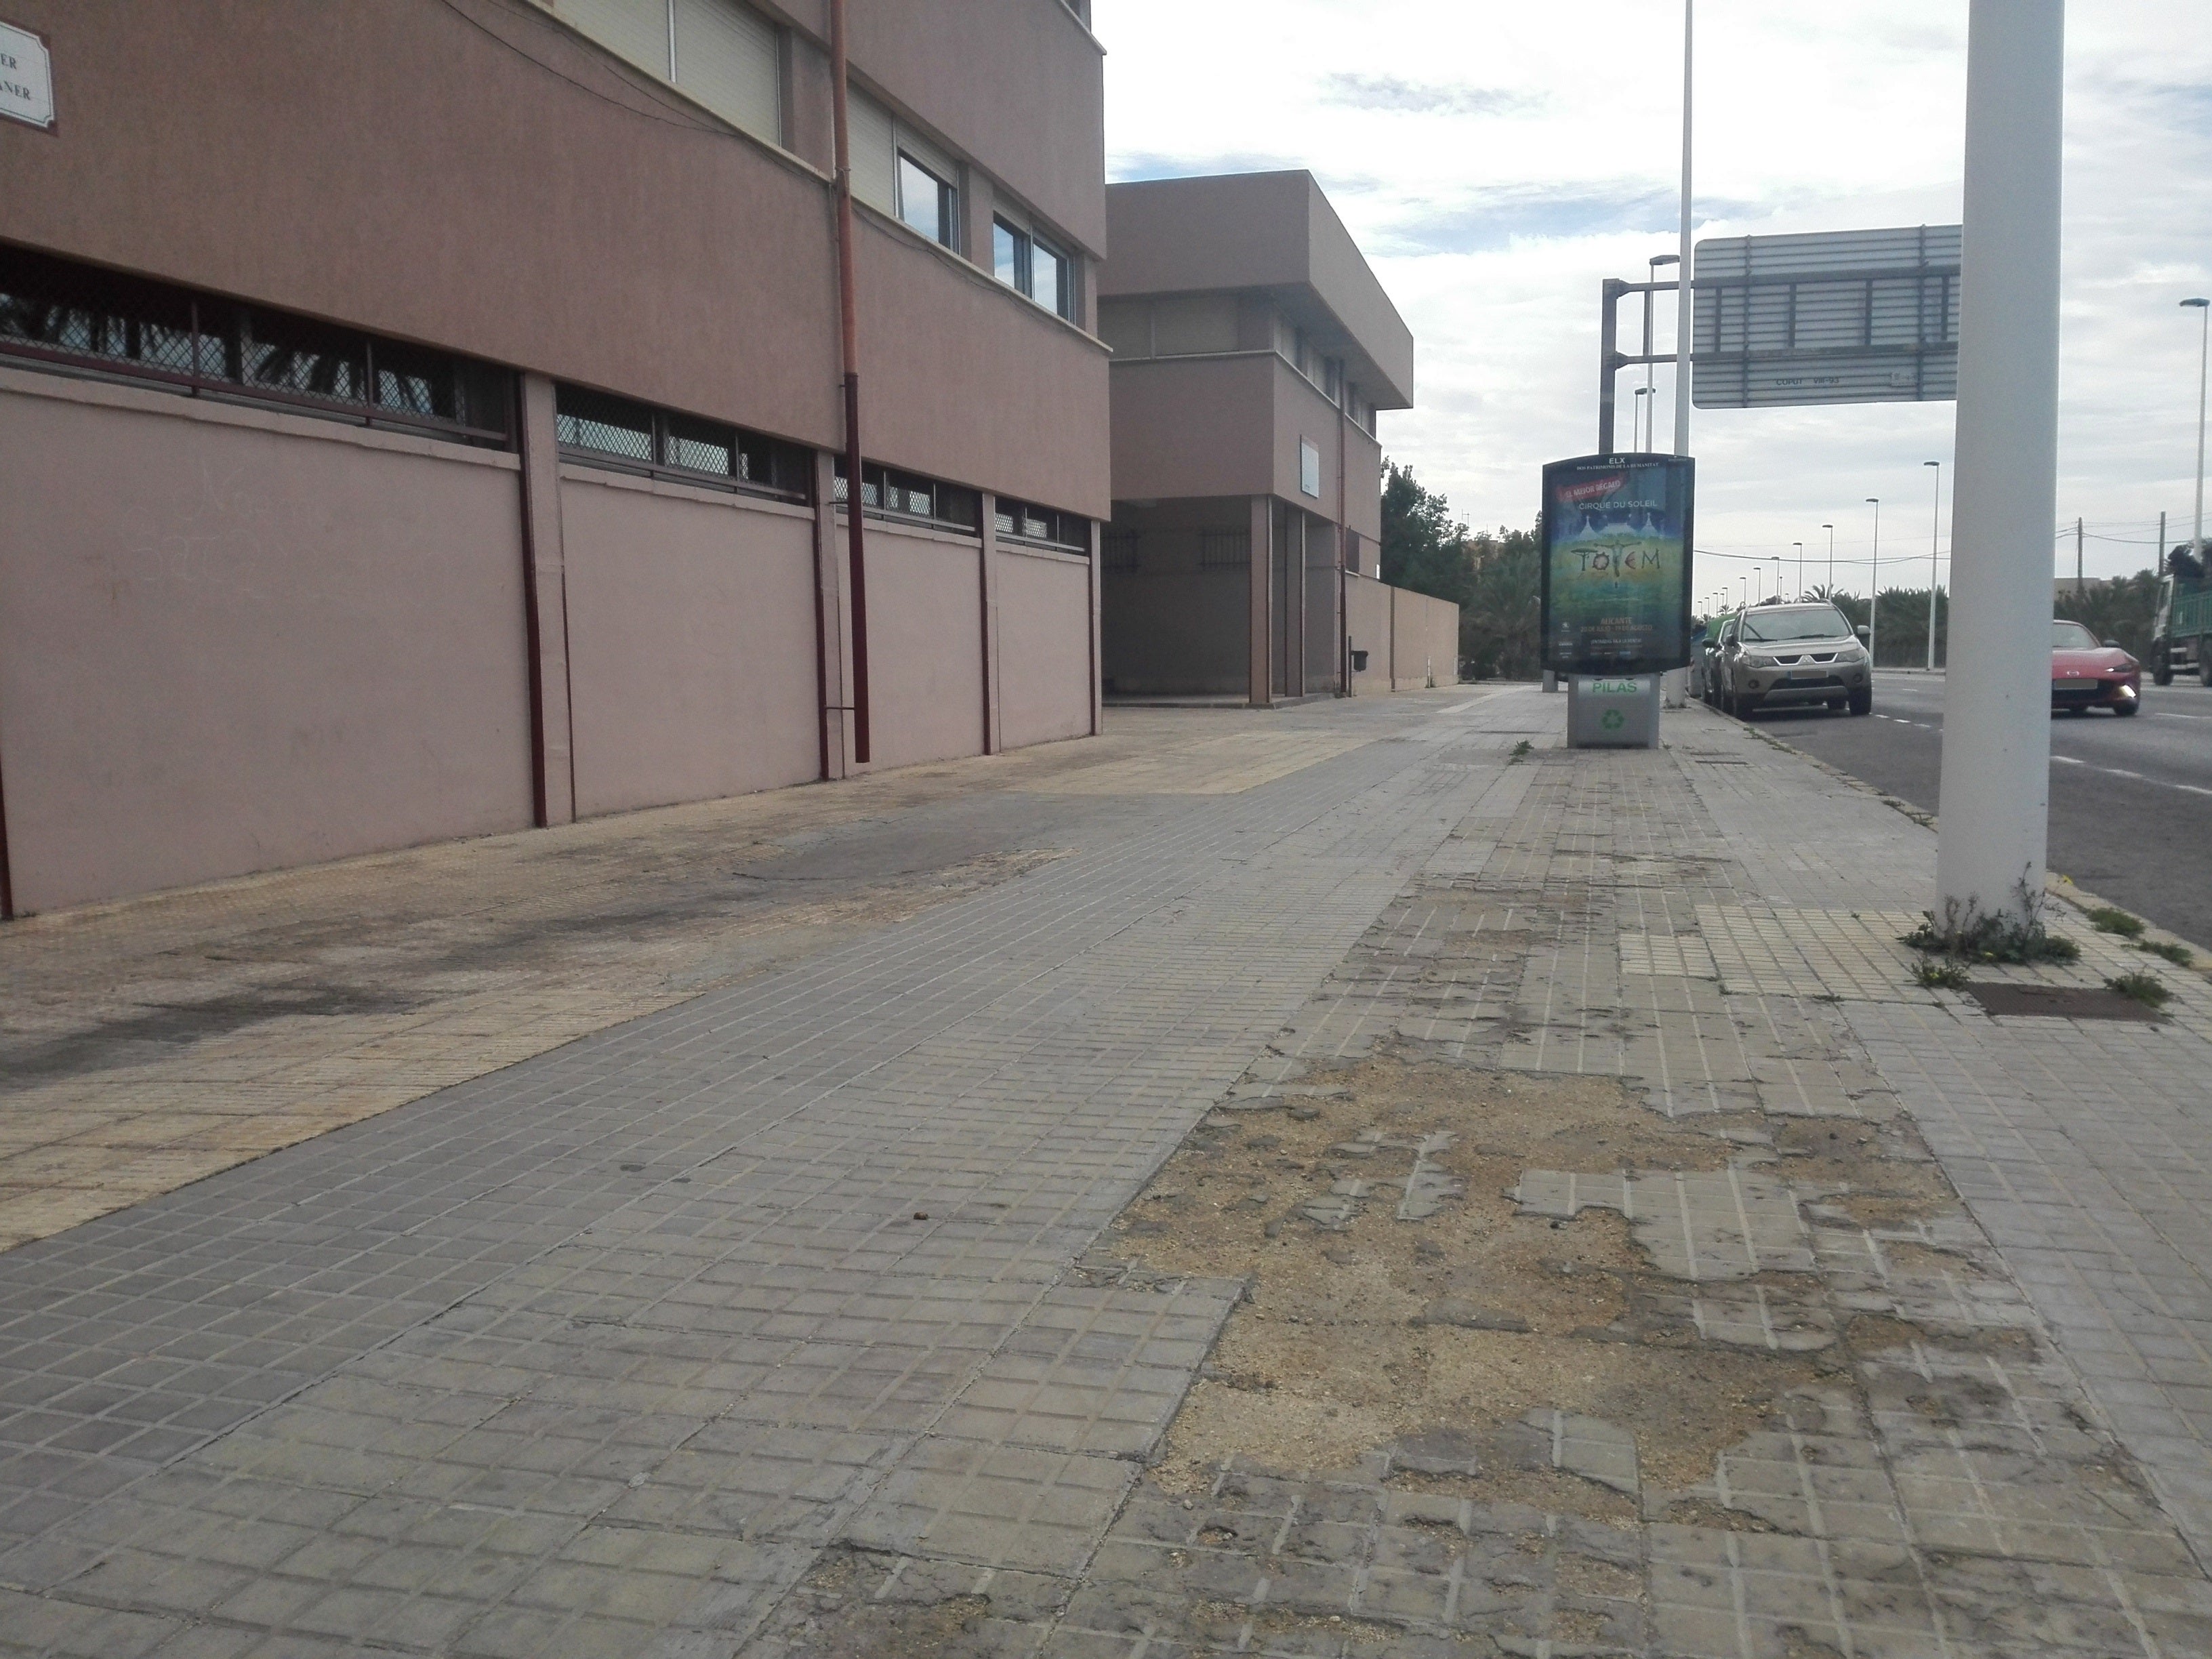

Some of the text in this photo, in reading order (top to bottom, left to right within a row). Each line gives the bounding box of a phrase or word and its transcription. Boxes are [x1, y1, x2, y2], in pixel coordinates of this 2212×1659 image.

[1574, 485, 1595, 496] MEJOR
[1595, 480, 1620, 491] REGALO
[1579, 501, 1611, 510] CIRQUE
[1628, 499, 1657, 508] SOLEIL
[1571, 540, 1660, 577] TOTEM
[1592, 682, 1637, 693] PILAS
